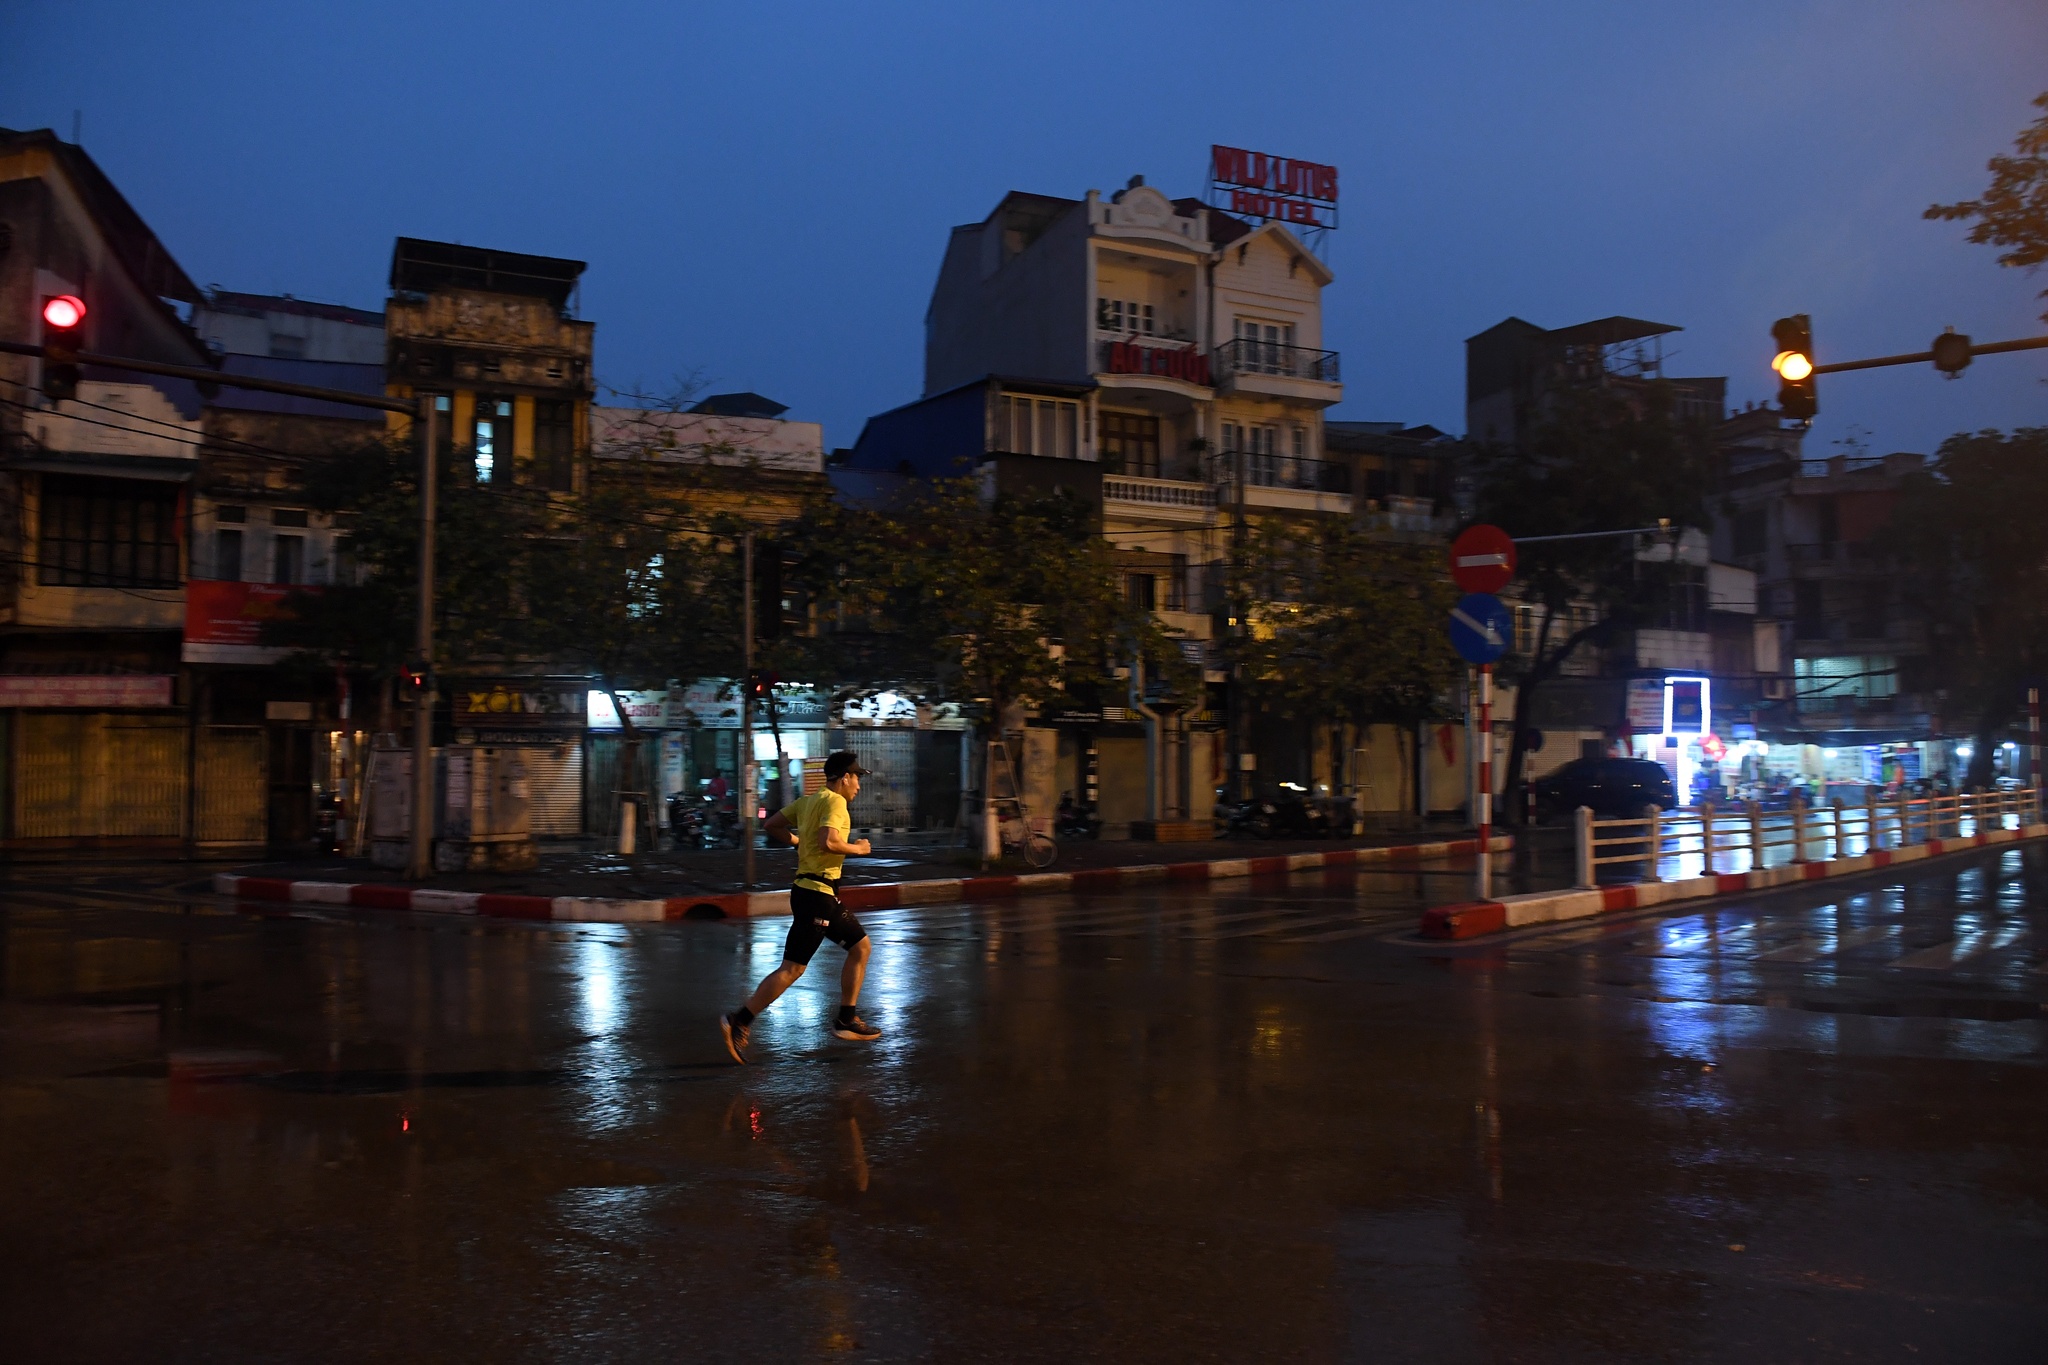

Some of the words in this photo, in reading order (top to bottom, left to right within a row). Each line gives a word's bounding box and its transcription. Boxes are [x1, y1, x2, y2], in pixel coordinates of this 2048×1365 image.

[1213, 145, 1267, 187] WILD
[1274, 156, 1338, 201] LOTUS
[1231, 190, 1320, 225] HOTEL
[467, 685, 522, 713] XÔI
